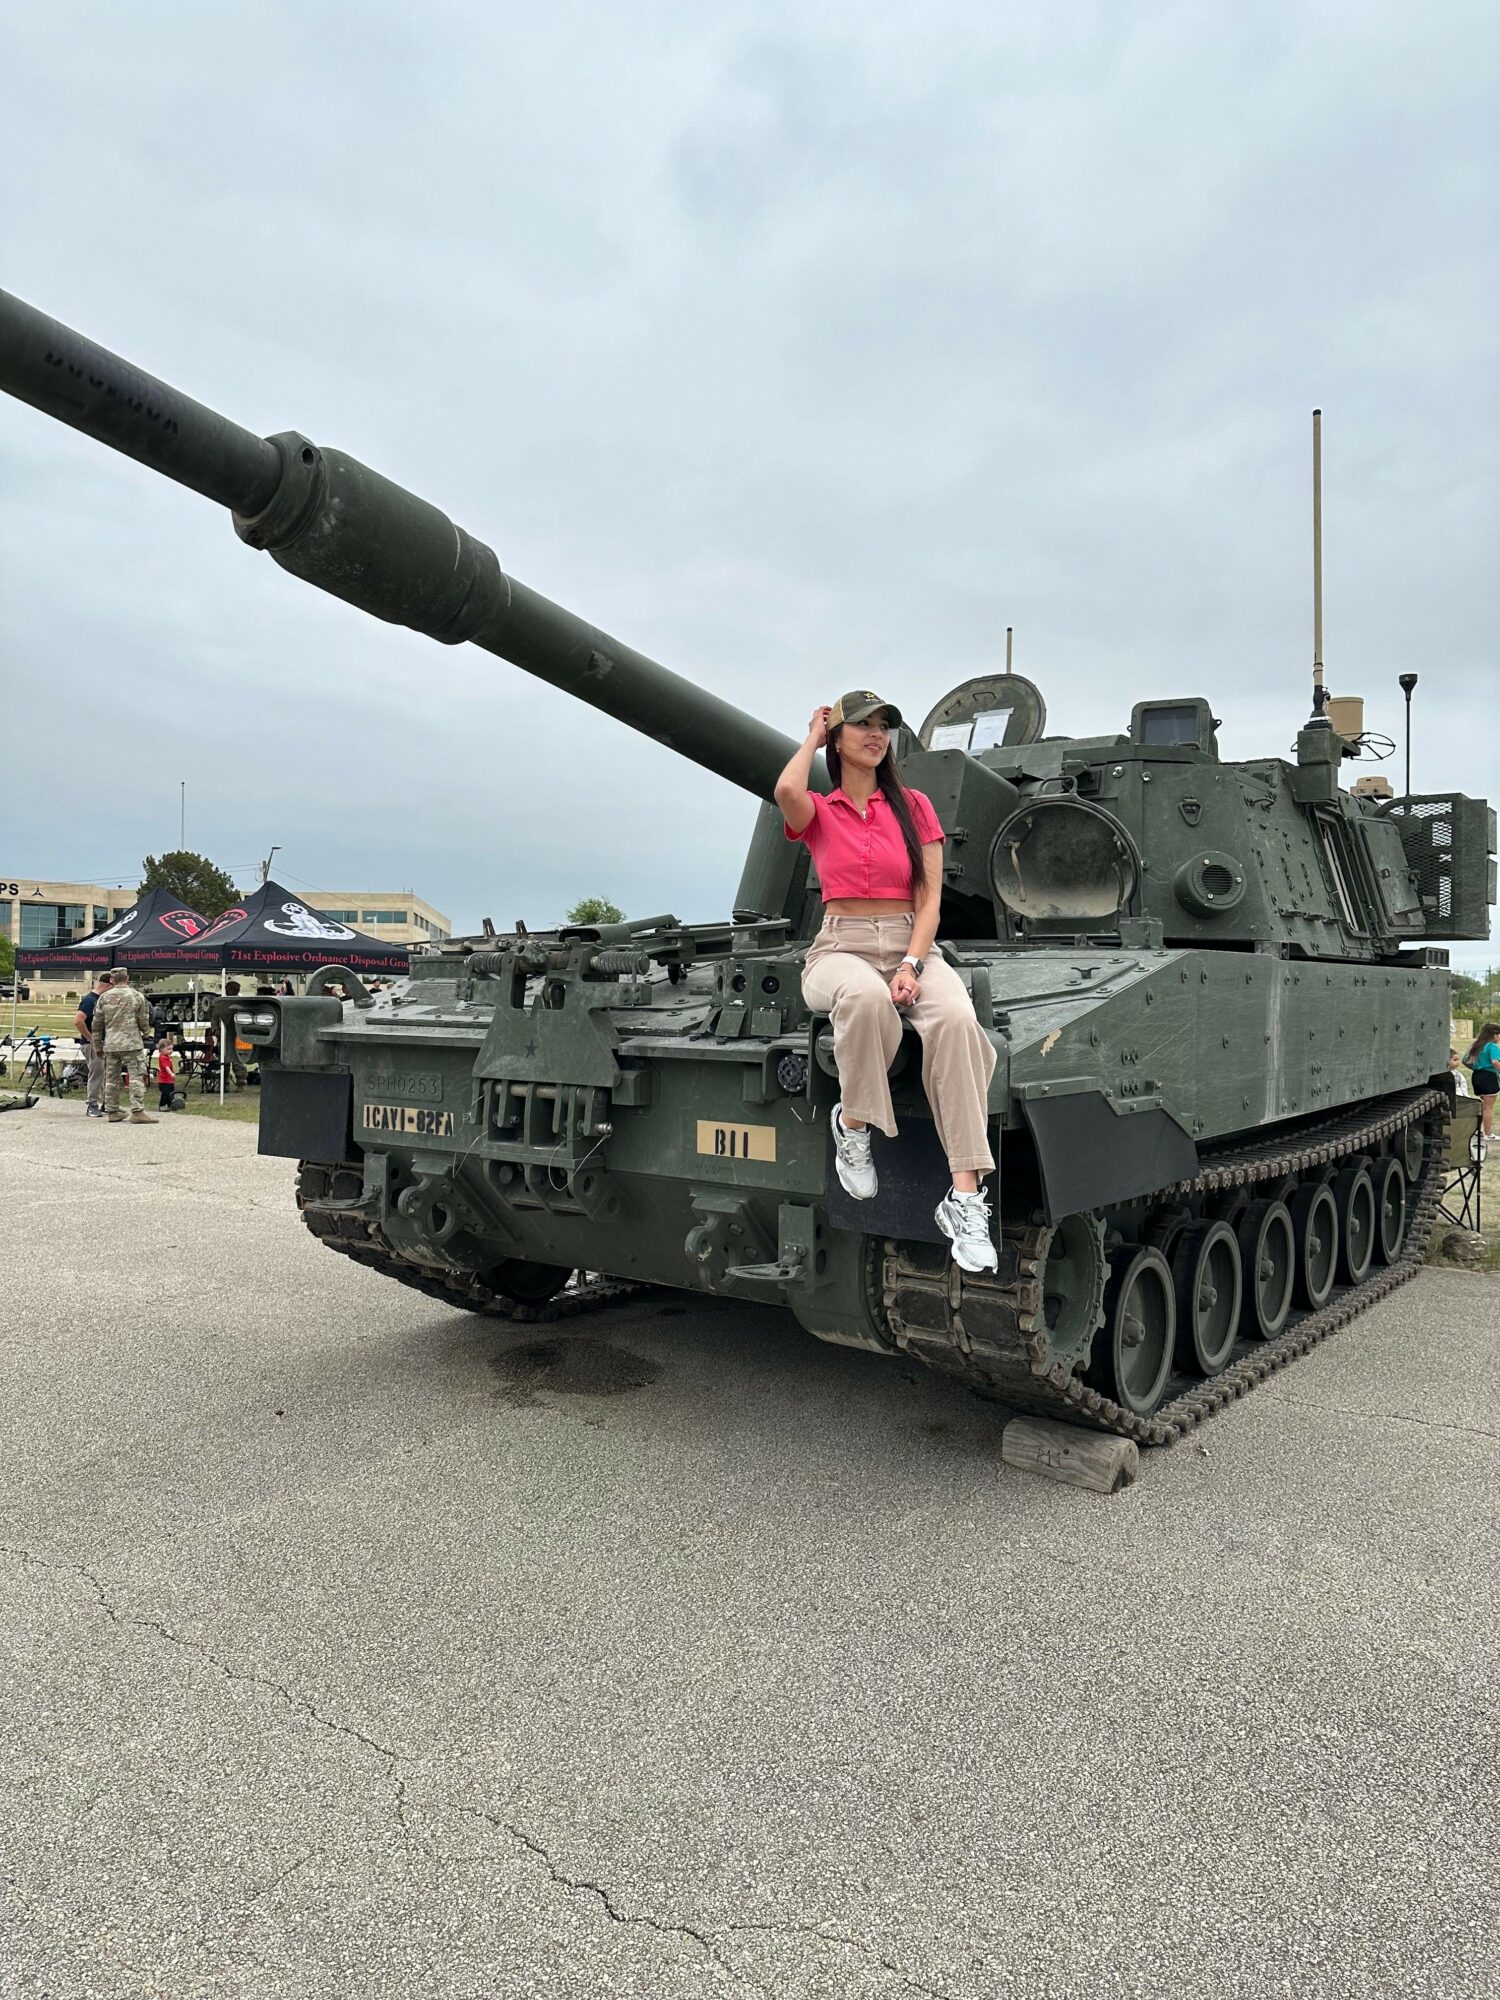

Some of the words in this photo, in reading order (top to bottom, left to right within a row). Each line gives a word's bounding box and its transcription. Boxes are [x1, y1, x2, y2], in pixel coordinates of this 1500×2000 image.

[177, 949, 200, 962] Disposal
[201, 949, 220, 962] Group
[231, 950, 252, 960] 71st
[254, 951, 300, 964] Explosive
[302, 952, 348, 964] Ordnance
[350, 954, 388, 968] Disposal
